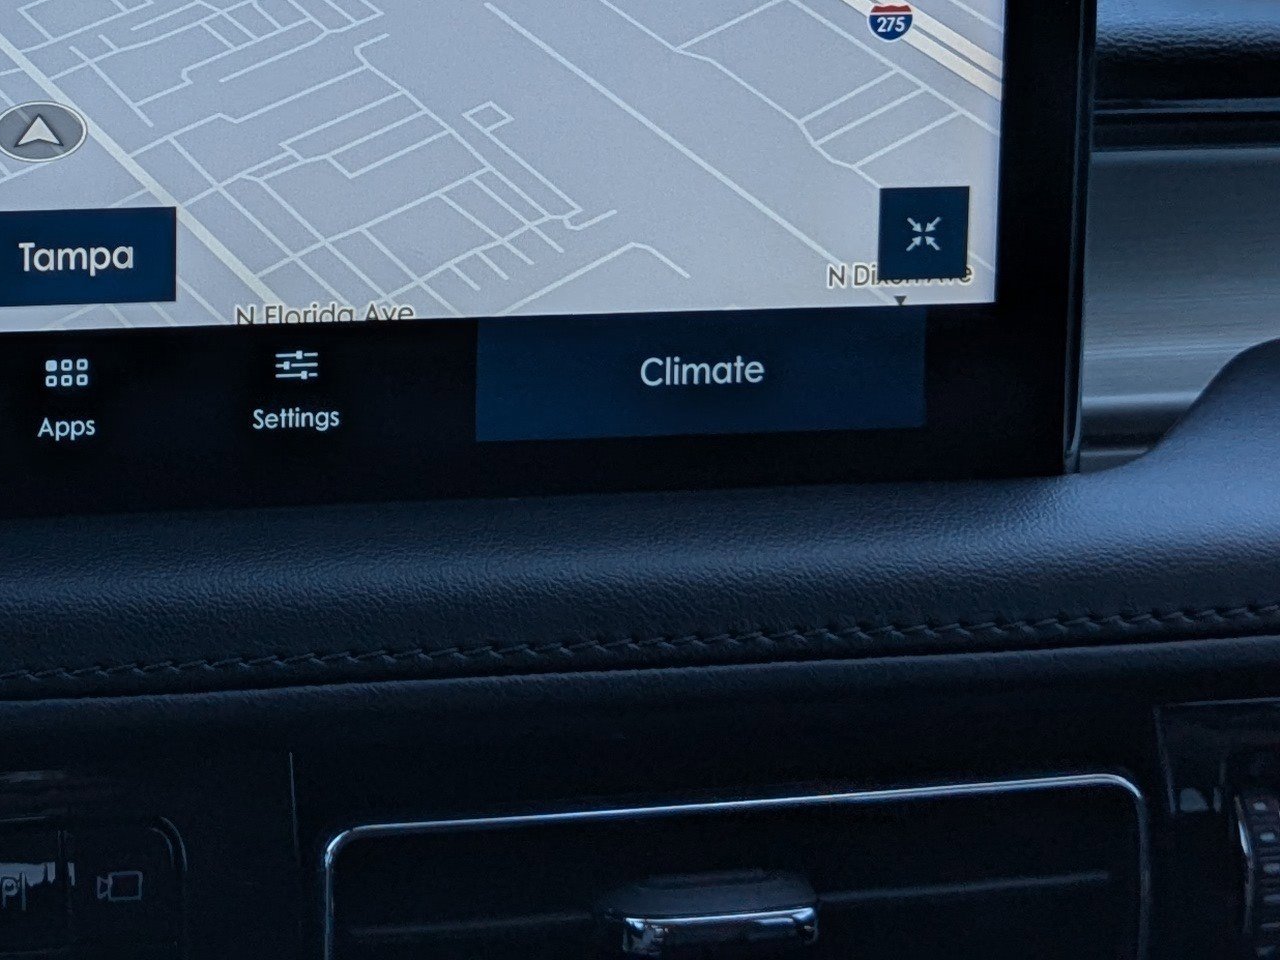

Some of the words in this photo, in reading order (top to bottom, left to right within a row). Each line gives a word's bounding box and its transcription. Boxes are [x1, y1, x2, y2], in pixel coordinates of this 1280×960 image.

[877, 16, 905, 32] 275
[18, 241, 135, 278] Tampa
[829, 265, 845, 287] N
[237, 306, 254, 325] N
[265, 304, 354, 324] Florida
[365, 303, 414, 321] Ave
[639, 354, 766, 388] Climate
[36, 416, 97, 444] Apps
[251, 405, 341, 433] Settings
